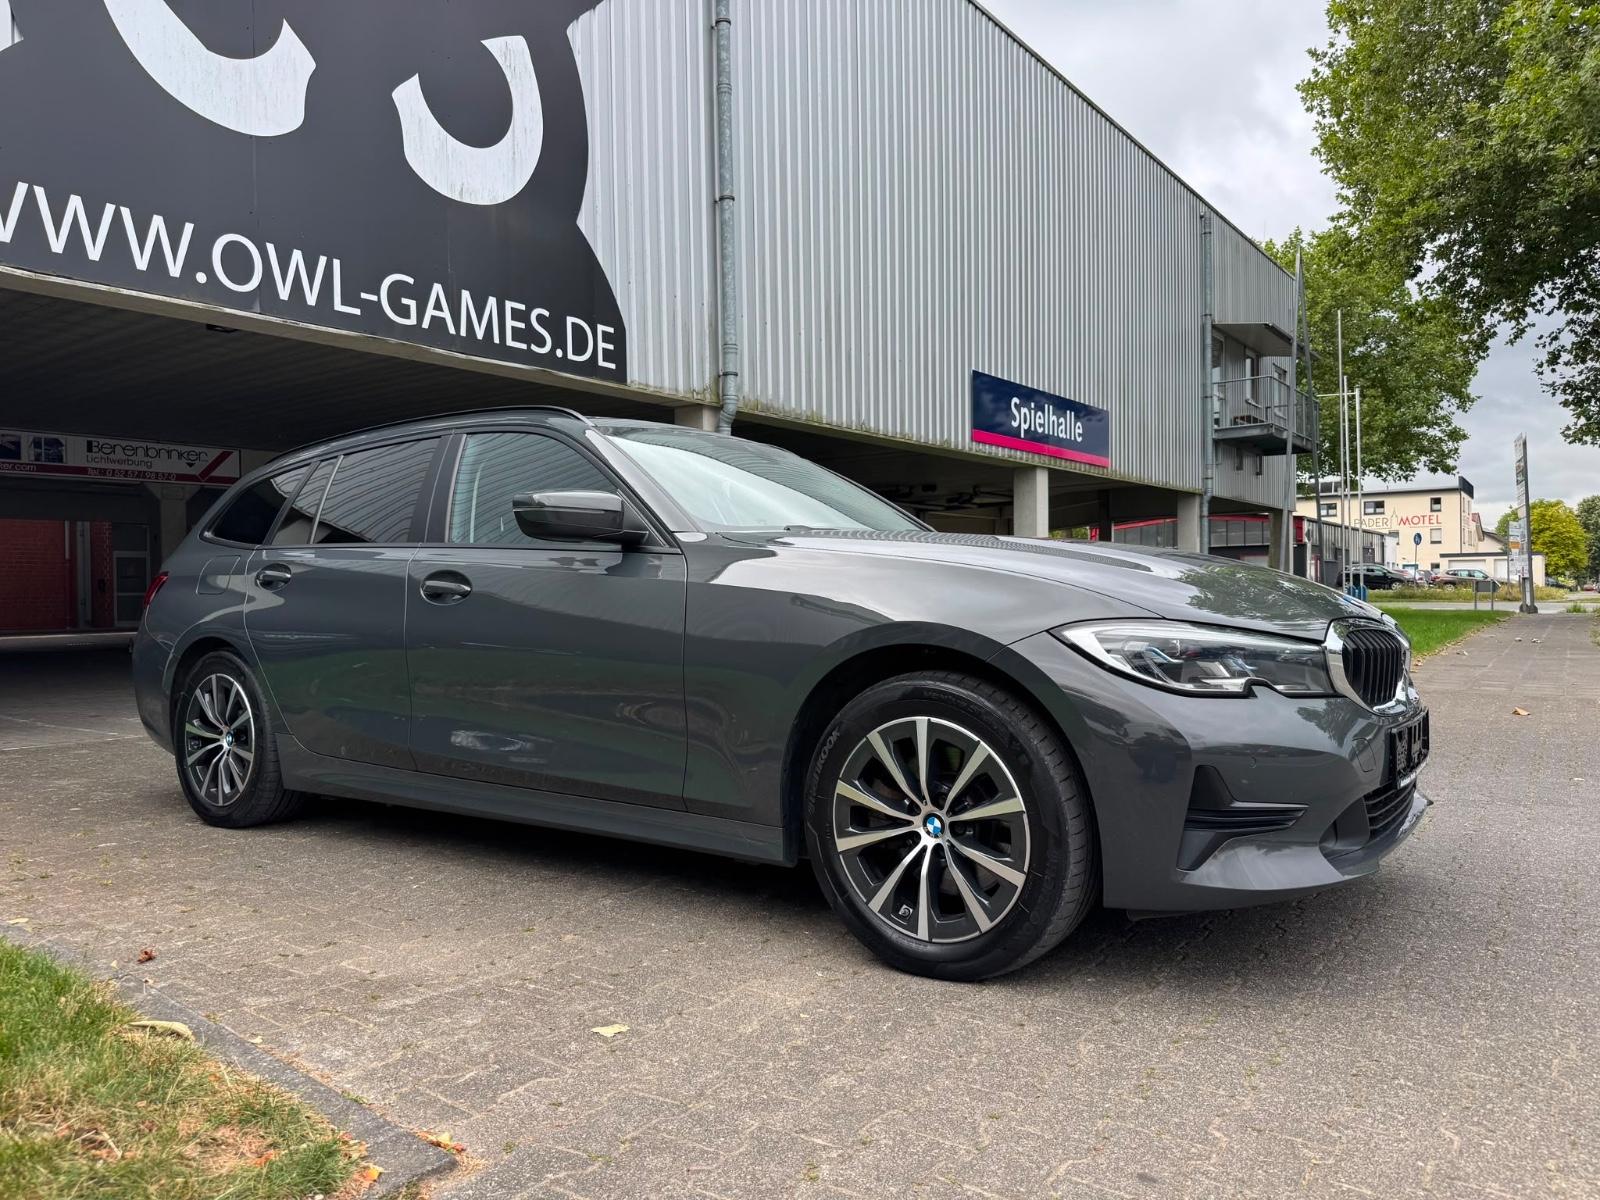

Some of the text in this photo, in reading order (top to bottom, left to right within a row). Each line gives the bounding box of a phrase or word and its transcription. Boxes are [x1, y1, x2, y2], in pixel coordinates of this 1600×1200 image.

[1010, 396, 1084, 443] Spielhalle
[86, 439, 209, 463] Berenbrinker
[86, 454, 153, 470] Lichtwerbung
[1353, 514, 1442, 528] PADER MOTEL
